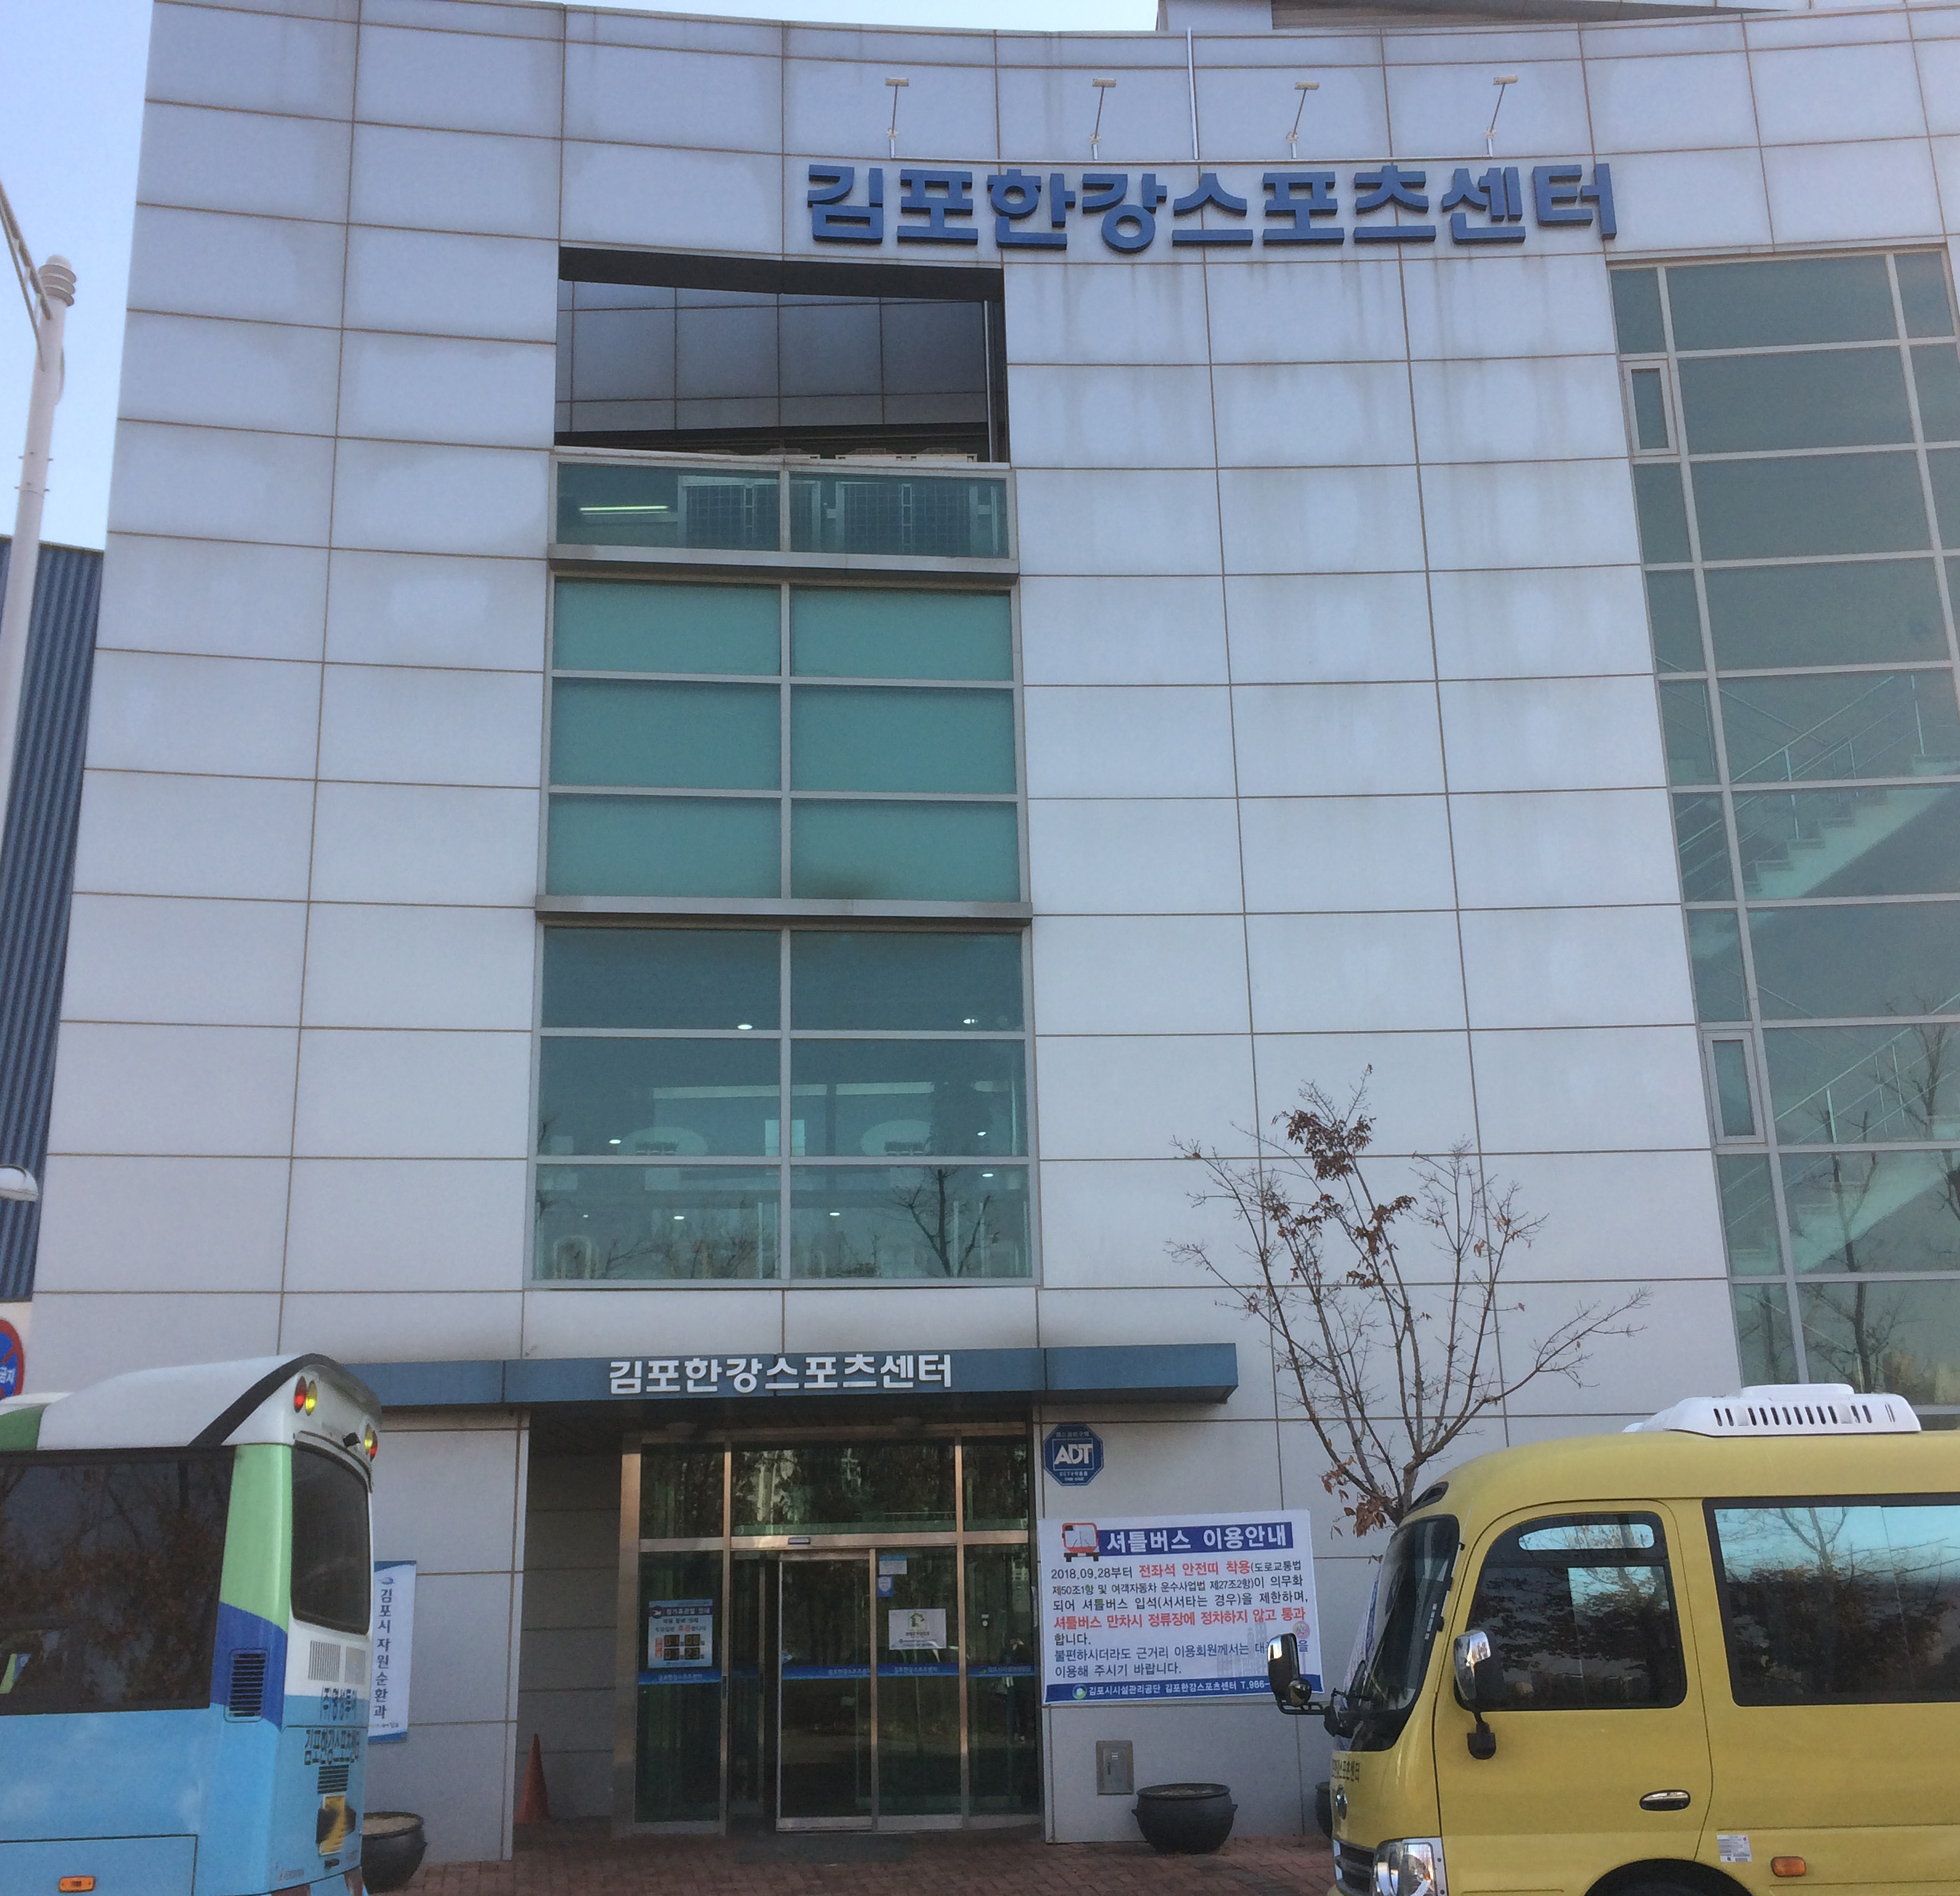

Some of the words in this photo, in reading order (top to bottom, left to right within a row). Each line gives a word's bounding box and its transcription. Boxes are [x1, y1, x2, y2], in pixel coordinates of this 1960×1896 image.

[807, 163, 1617, 255] 김포한강스포츠센터
[609, 1353, 952, 1395] 김포한강스포츠센터
[1054, 1444, 1094, 1464] ADT
[1107, 1529, 1191, 1553] 셔틀버스
[1203, 1524, 1287, 1549] 이용안내
[1051, 1566, 1132, 1580] 2018.09.28부터
[1139, 1563, 1175, 1578] 전좌석
[1182, 1561, 1219, 1576] 안전띠
[1226, 1560, 1301, 1574] 착용(도로교통법
[1052, 1584, 1094, 1596] 제50조1항
[1098, 1585, 1107, 1594] 및
[1111, 1582, 1156, 1594] 여객자동차
[1161, 1581, 1205, 1593] 운수사업법
[1210, 1577, 1264, 1590] 제27조2항)이
[1271, 1574, 1303, 1588] 의무화
[377, 1589, 393, 1634] 김포시
[1053, 1598, 1074, 1612] 되어
[1082, 1597, 1128, 1611] 셔틀버스
[1135, 1594, 1207, 1609] 입석(서서타는
[1215, 1593, 1253, 1606] 경우)을
[1259, 1590, 1308, 1605] 제한하며,
[1054, 1614, 1102, 1629] 셔틀버스
[1107, 1613, 1143, 1629] 만차시
[1148, 1611, 1195, 1627] 정류장에
[1200, 1609, 1248, 1625] 정차하지
[1253, 1608, 1277, 1623] 않고
[1282, 1606, 1306, 1621] 통과
[1054, 1633, 1091, 1645] 합니다.
[1054, 1648, 1131, 1662] 불편하시더라도
[1136, 1646, 1169, 1659] 근거리
[1175, 1642, 1249, 1658] 이용회원께서는
[373, 1637, 391, 1720] 자원순환과
[1055, 1665, 1089, 1678] 이용해
[1094, 1664, 1128, 1677] 주시기
[1134, 1661, 1182, 1676] 바랍니다.
[1089, 1684, 1161, 1696] 김포시시설관리공단
[1165, 1681, 1237, 1693] 김포한강스포츠센터
